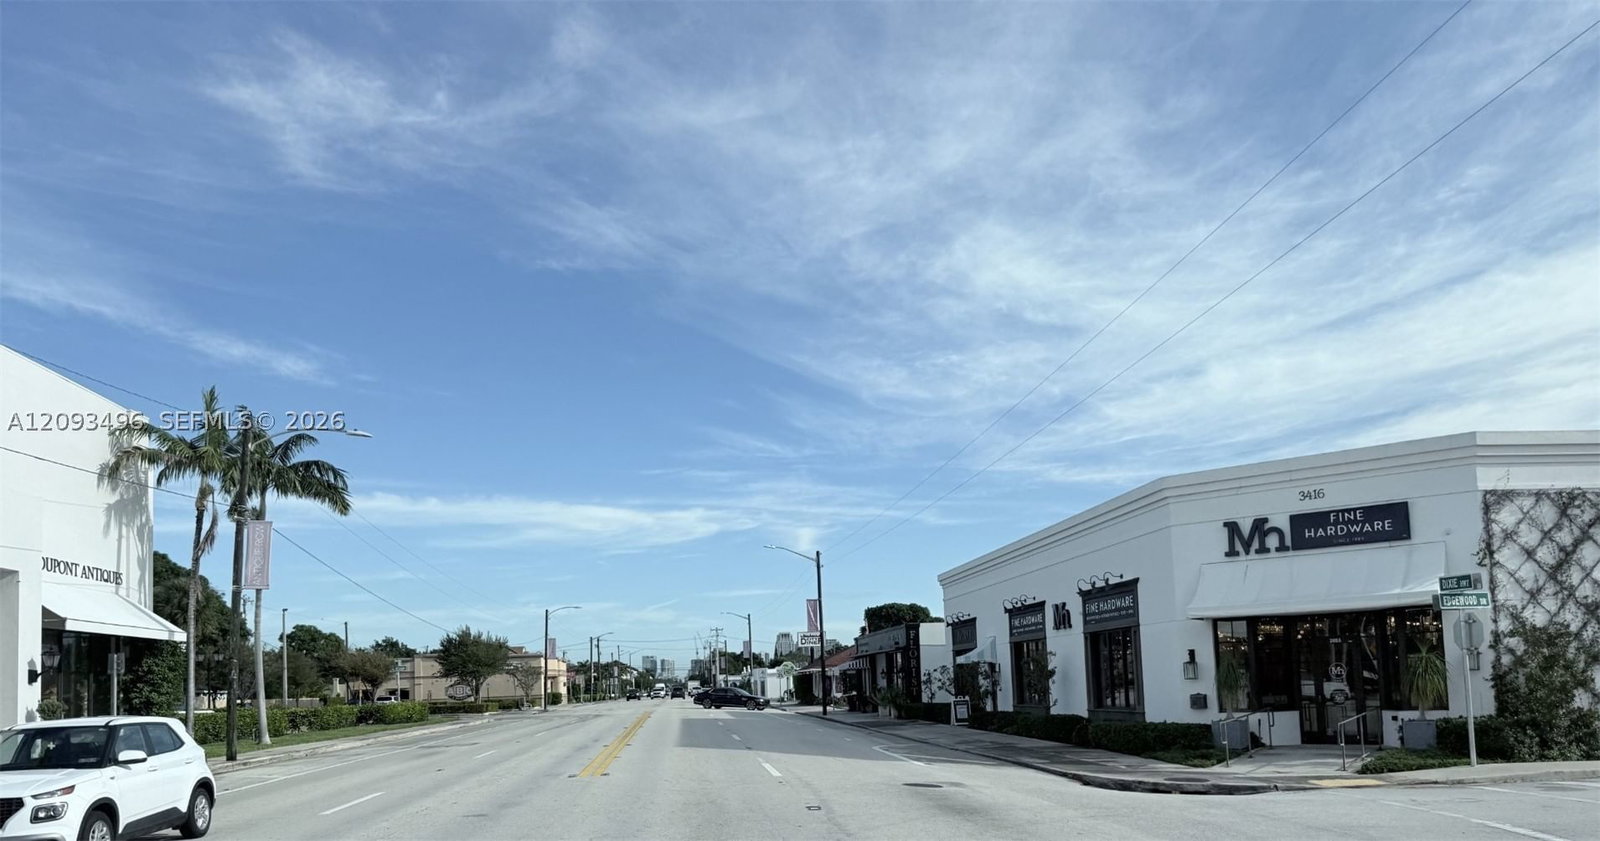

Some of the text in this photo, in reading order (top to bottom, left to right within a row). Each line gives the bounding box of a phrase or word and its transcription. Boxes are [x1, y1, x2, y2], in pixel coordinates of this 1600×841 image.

[1299, 489, 1325, 501] 3416
[1330, 509, 1364, 523] FINE
[1223, 517, 1291, 557] Mn
[1305, 519, 1393, 539] HARDWARE
[80, 565, 123, 586] ANTIQUES
[1441, 578, 1458, 589] DIXIE
[1085, 595, 1134, 614] FINE HARDWARE
[1443, 595, 1478, 606] EDGEWOOD
[909, 630, 919, 696] FLORIST
